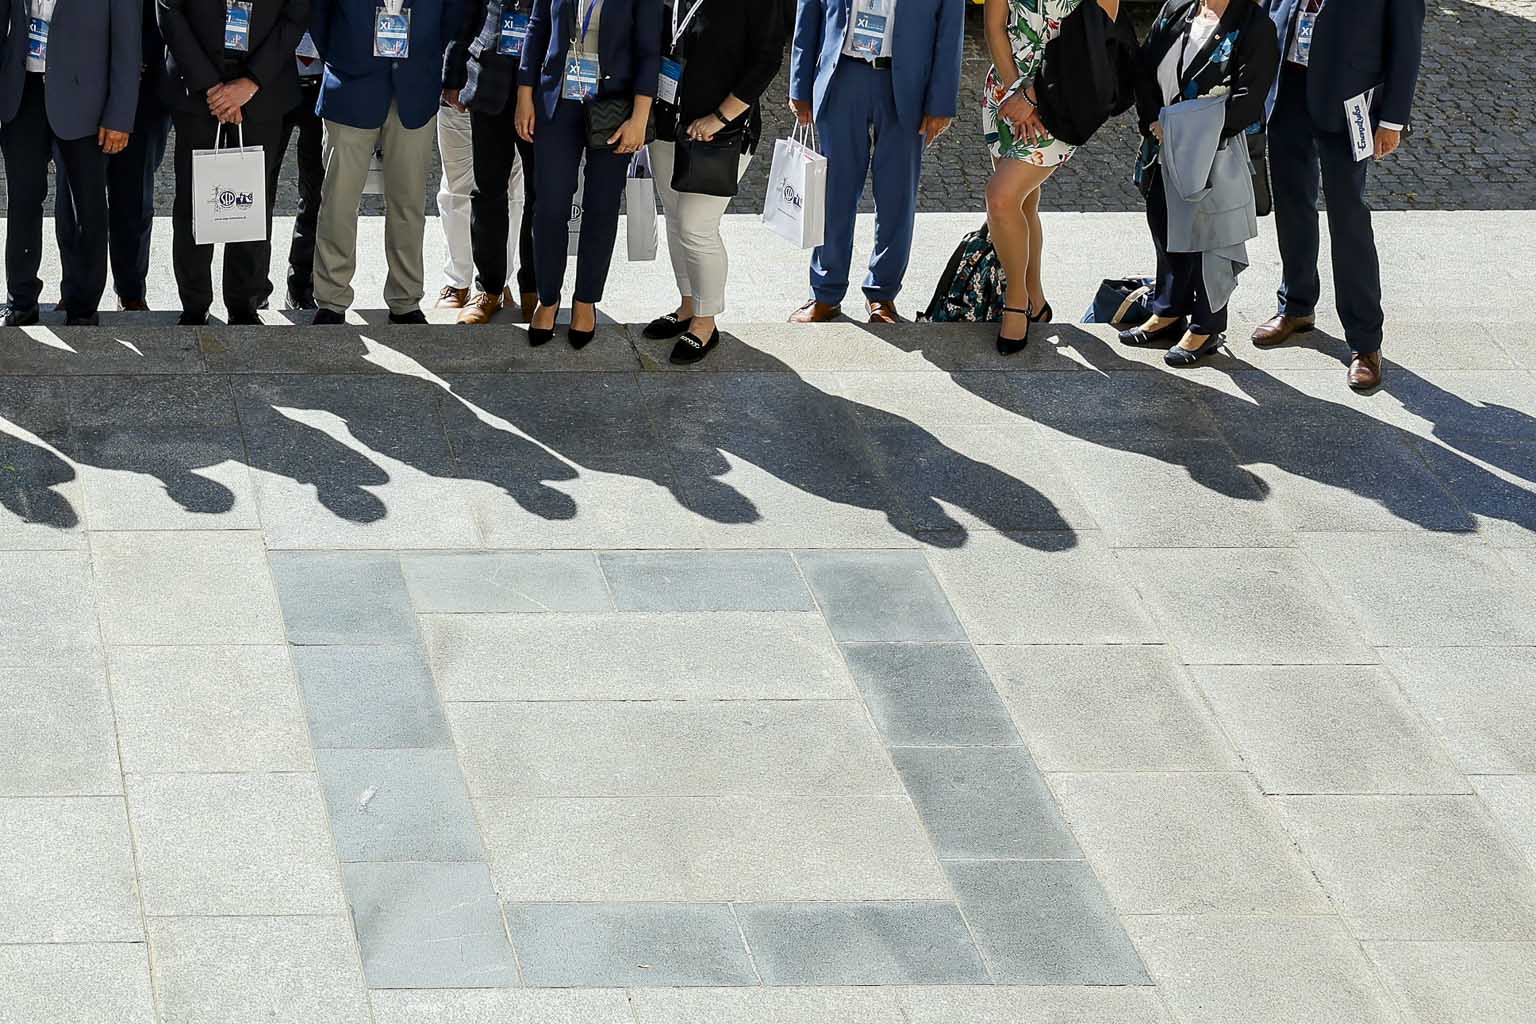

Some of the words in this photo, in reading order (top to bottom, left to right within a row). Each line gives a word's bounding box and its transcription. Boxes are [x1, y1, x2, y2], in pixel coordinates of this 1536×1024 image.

[380, 21, 391, 30] XI
[504, 20, 513, 29] XI
[858, 18, 868, 28] XI
